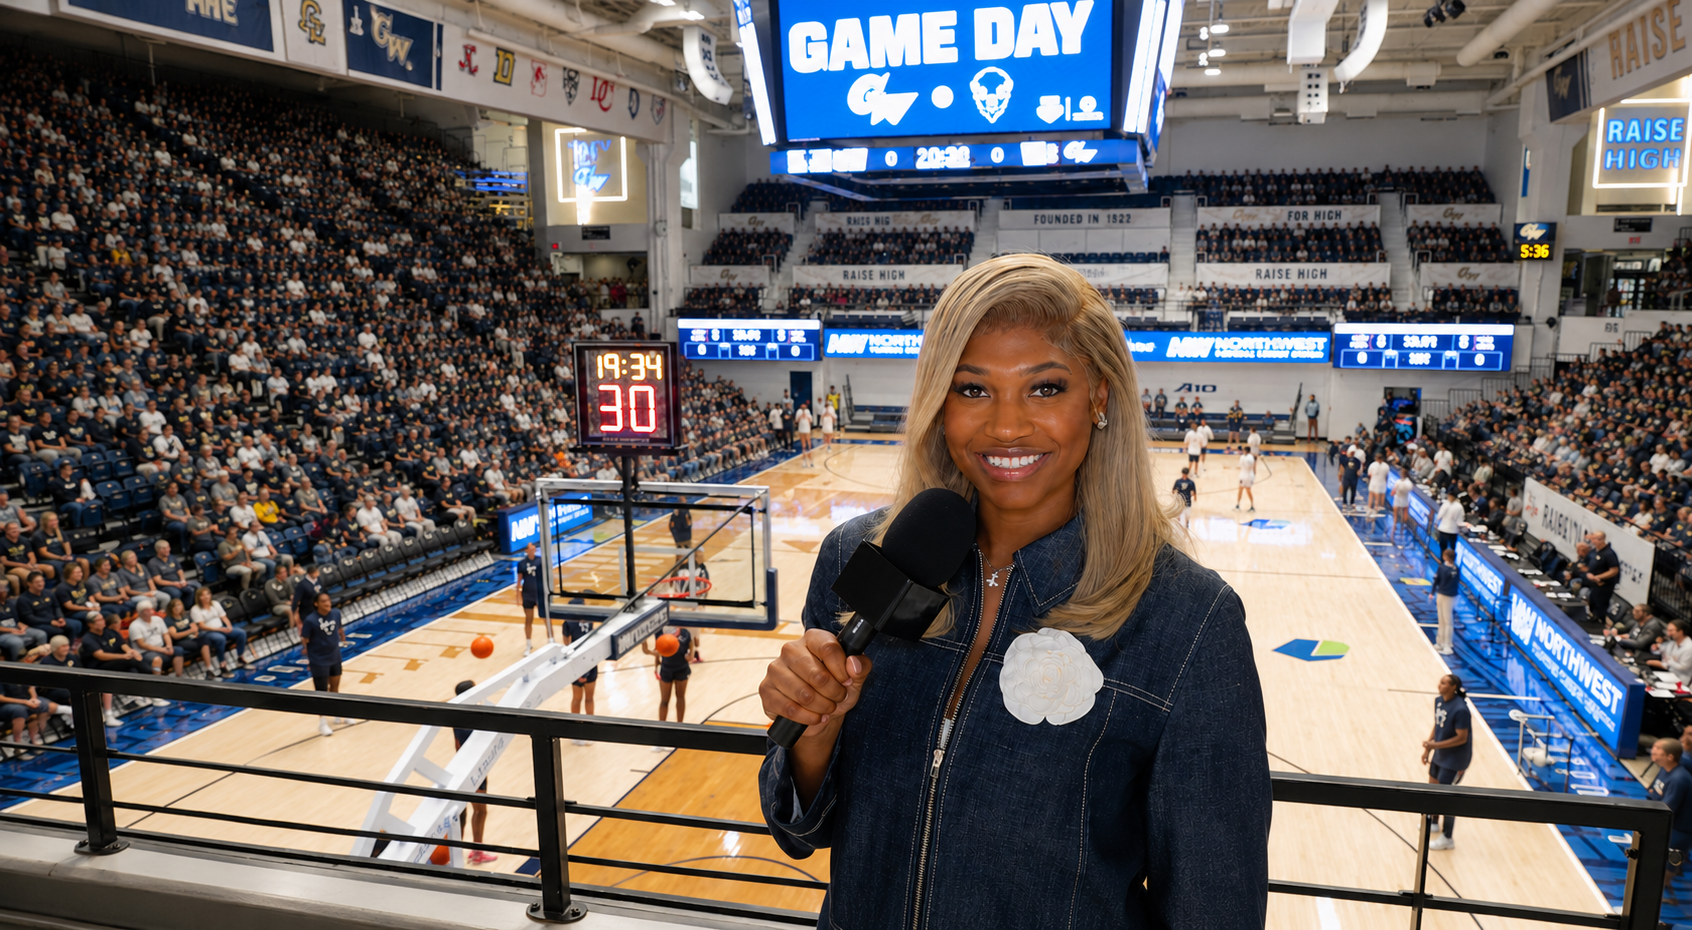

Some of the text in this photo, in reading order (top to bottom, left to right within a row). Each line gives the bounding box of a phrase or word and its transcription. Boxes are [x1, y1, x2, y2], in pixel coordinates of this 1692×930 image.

[788, 0, 1095, 74] GAME DAY
[1606, 118, 1685, 144] RAISE
[885, 151, 898, 167] 0
[991, 147, 1004, 163] 0
[1604, 148, 1682, 170] HIGH
[1034, 213, 1084, 224] FOUNDED
[1088, 213, 1100, 224] IN
[1287, 210, 1342, 221] FOR HIGH
[1520, 243, 1550, 259] 5:36
[843, 270, 905, 280] RAISE HIGH
[1256, 269, 1328, 280] RAISE HIGH
[1215, 337, 1328, 350] NORTHWEST
[597, 353, 663, 380] 19:34
[1174, 383, 1217, 393] A10
[598, 384, 657, 433] 30
[1535, 616, 1623, 715] NORTHWEST
